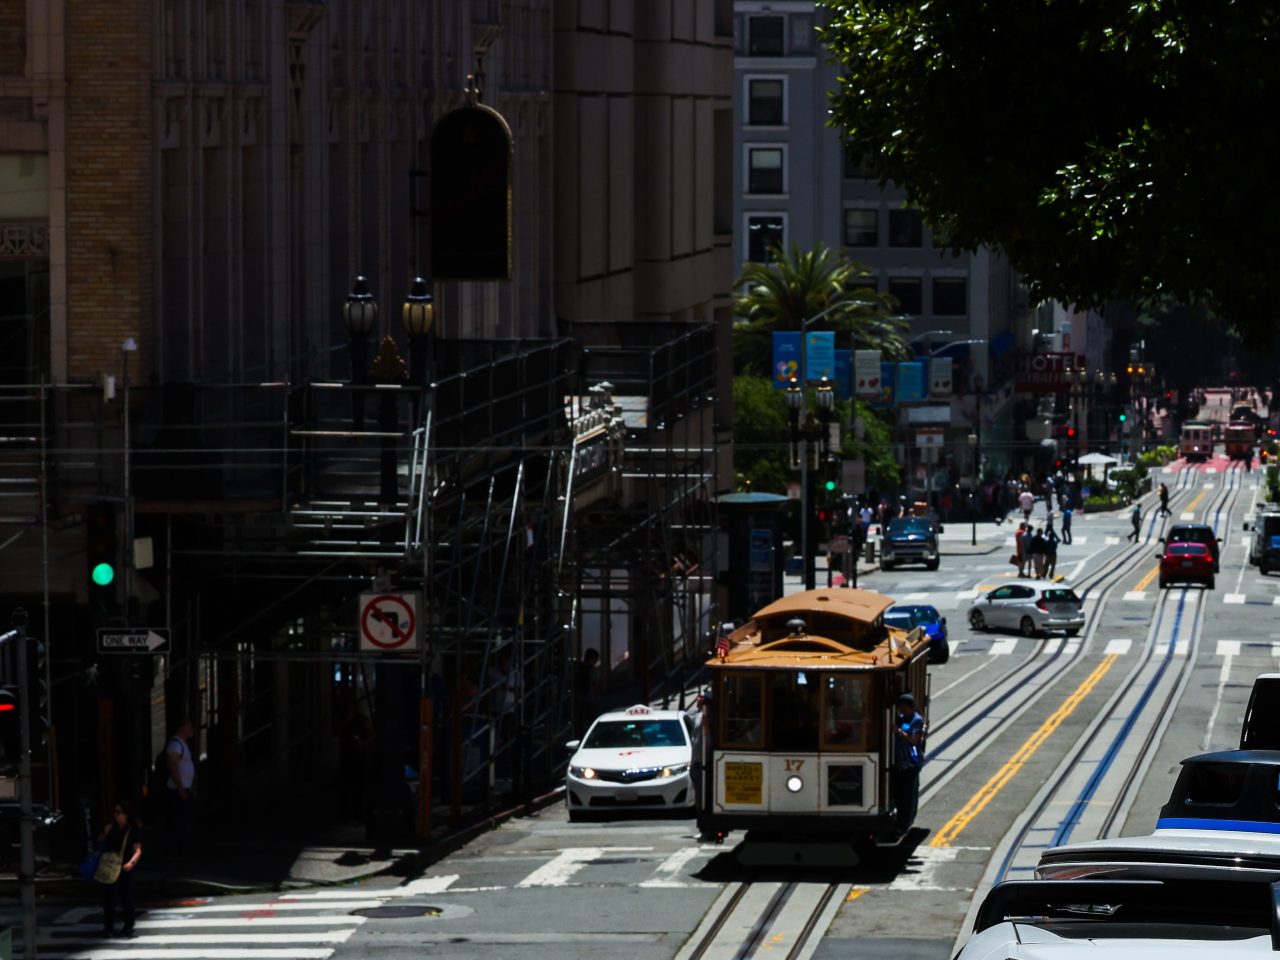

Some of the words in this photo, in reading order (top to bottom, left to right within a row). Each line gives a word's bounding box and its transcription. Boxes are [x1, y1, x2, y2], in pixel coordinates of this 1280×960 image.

[1020, 354, 1082, 371] HOTEL
[105, 635, 125, 646] ONE
[128, 635, 149, 645] WAY
[784, 758, 805, 772] 17
